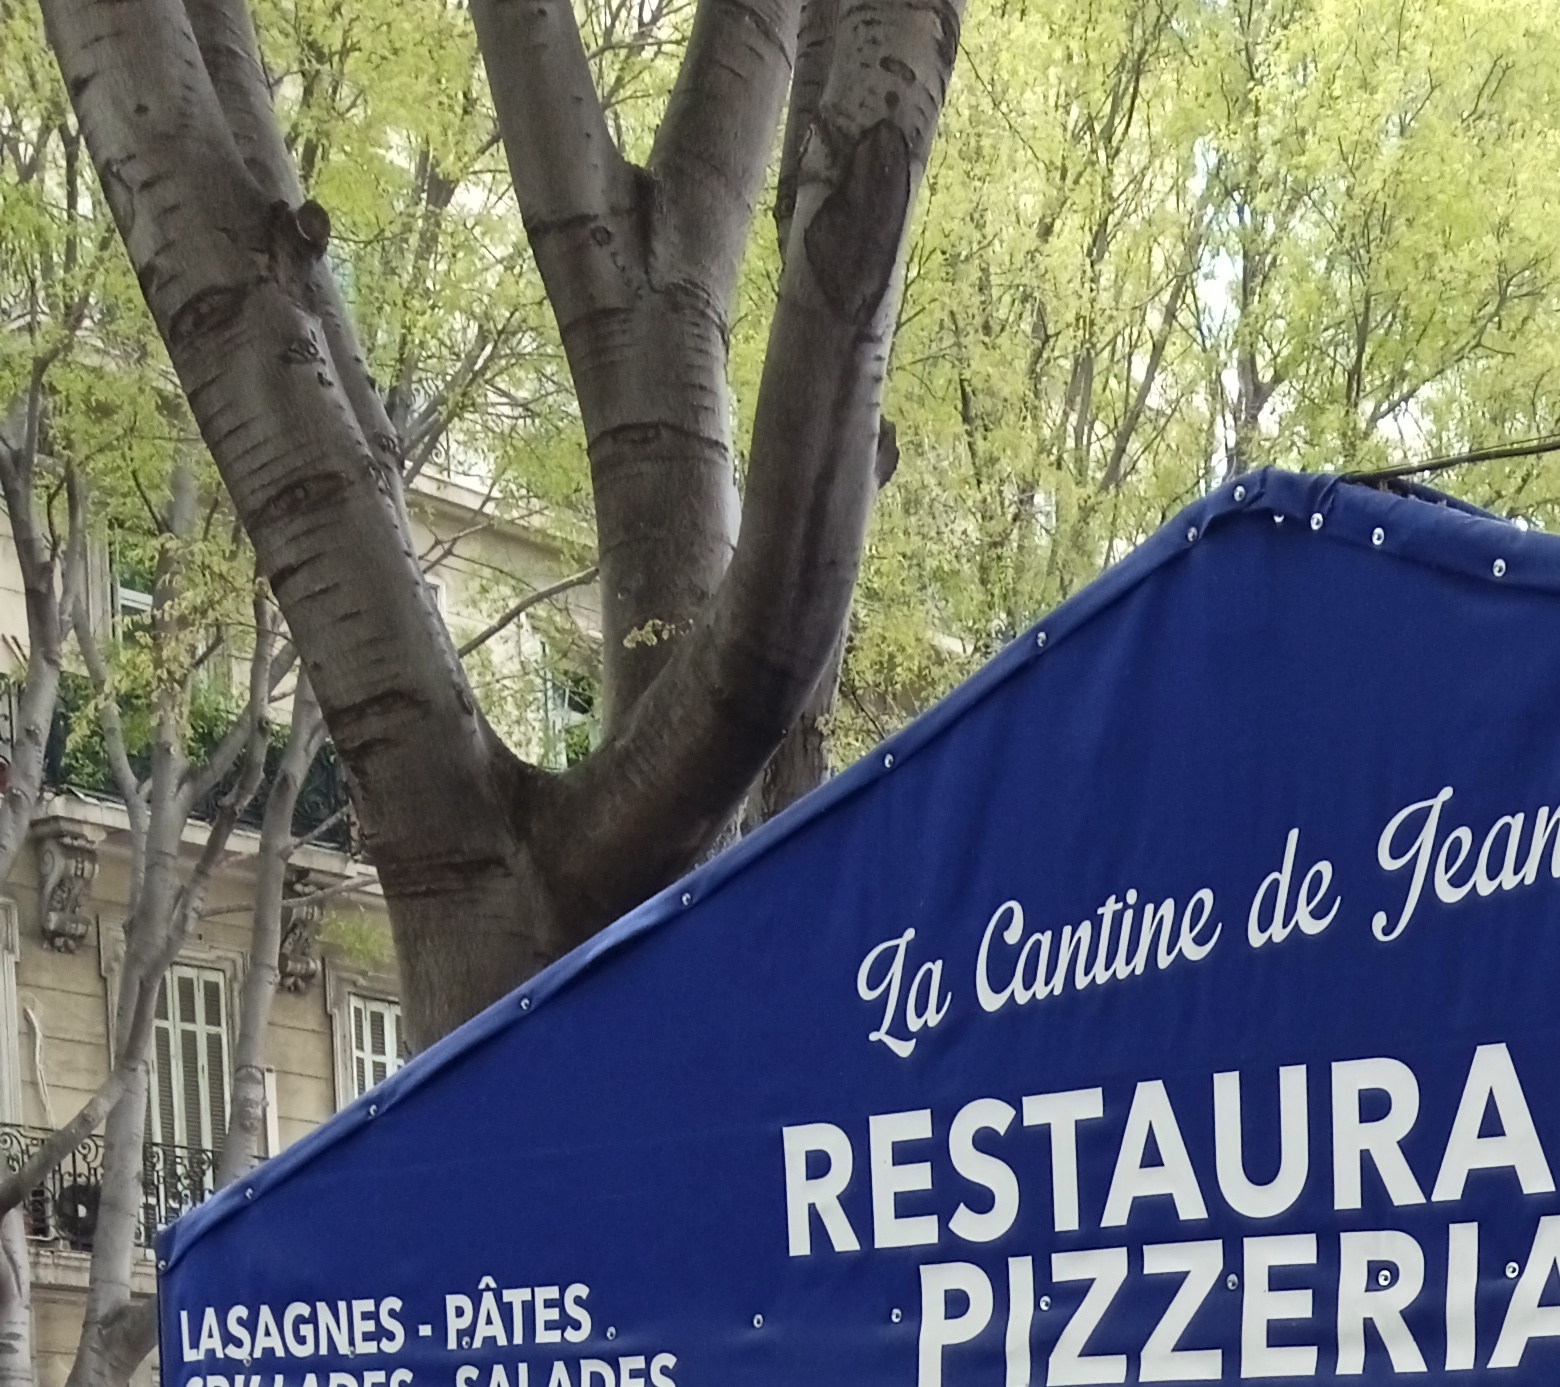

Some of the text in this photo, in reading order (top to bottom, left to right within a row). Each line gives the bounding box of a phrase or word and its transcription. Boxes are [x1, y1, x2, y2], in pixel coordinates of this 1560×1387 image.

[856, 927, 950, 1057] La
[975, 887, 1223, 1012] Cantine
[1247, 828, 1341, 947] de
[180, 1275, 592, 1362] LASAGNES PÂTES
